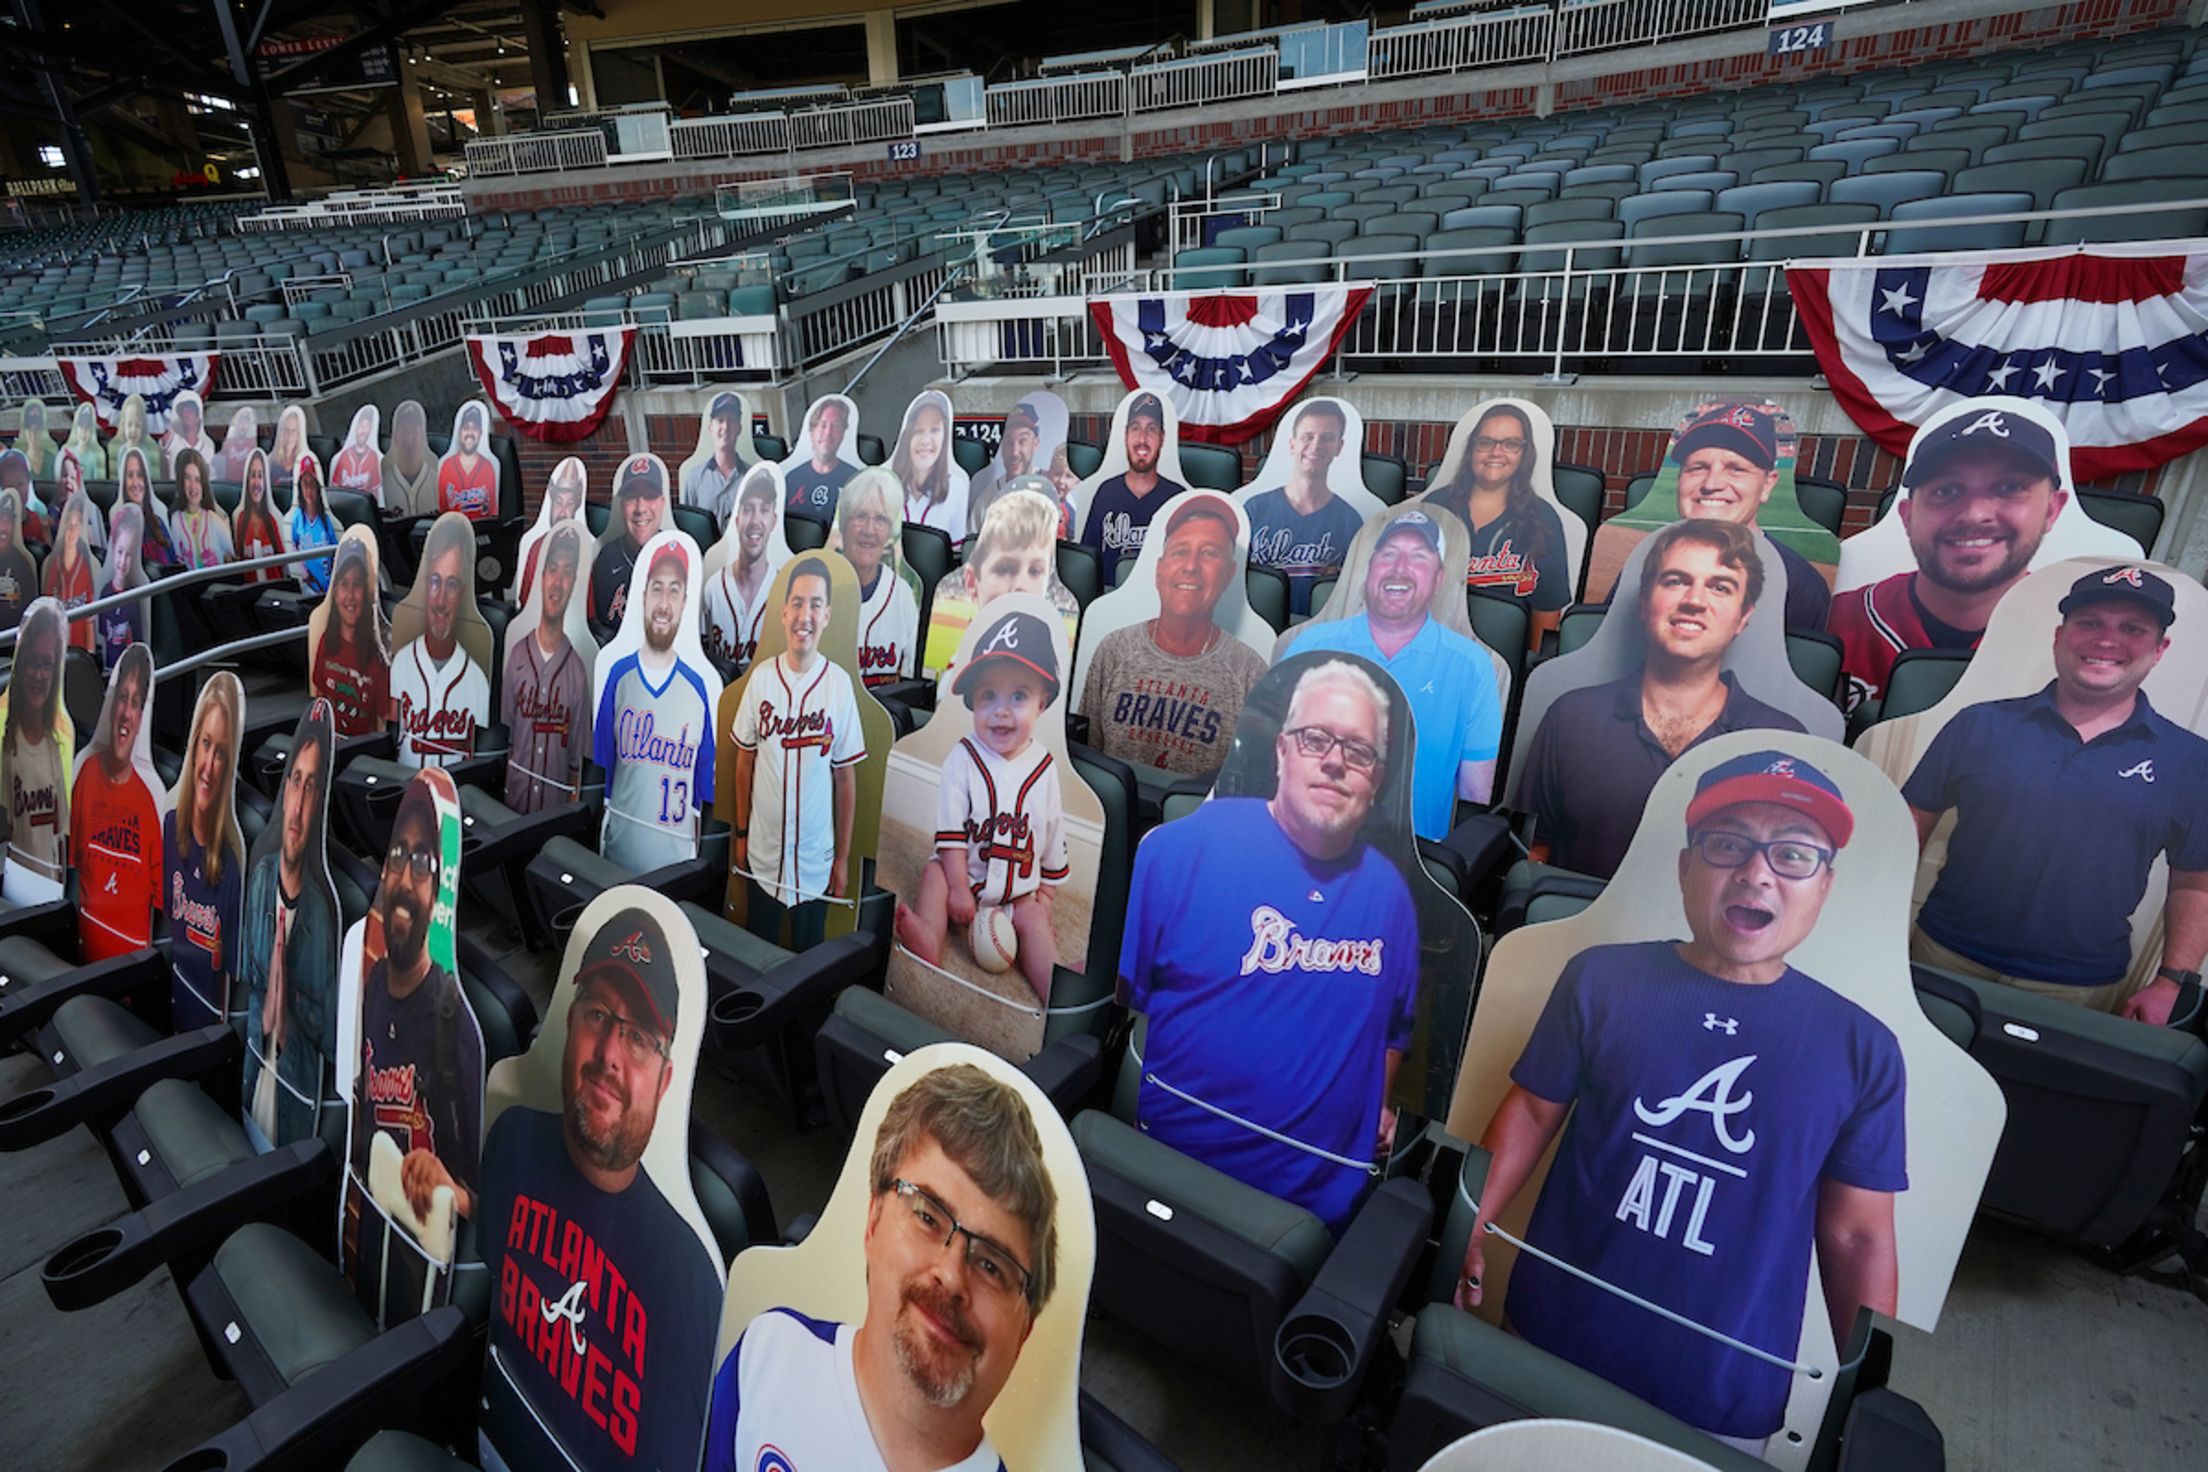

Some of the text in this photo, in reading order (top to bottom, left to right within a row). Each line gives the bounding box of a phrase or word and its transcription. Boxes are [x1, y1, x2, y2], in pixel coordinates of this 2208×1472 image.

[1777, 24, 1824, 53] 124
[893, 142, 917, 160] 123
[970, 423, 1002, 443] 124
[1961, 411, 2010, 438] A
[983, 617, 1019, 655] A
[1134, 678, 1210, 706] ATLANTA
[619, 704, 695, 769] Atlanta
[759, 700, 825, 741] Braves
[1112, 691, 1222, 744] BRAVES
[2117, 758, 2155, 783] A
[657, 774, 690, 826] 13
[1240, 904, 1384, 977] Braves
[1633, 1055, 1759, 1154] A
[1615, 1154, 1717, 1257] ATL
[506, 1192, 648, 1381] ATLANTA
[500, 1252, 642, 1458] BRAVES
